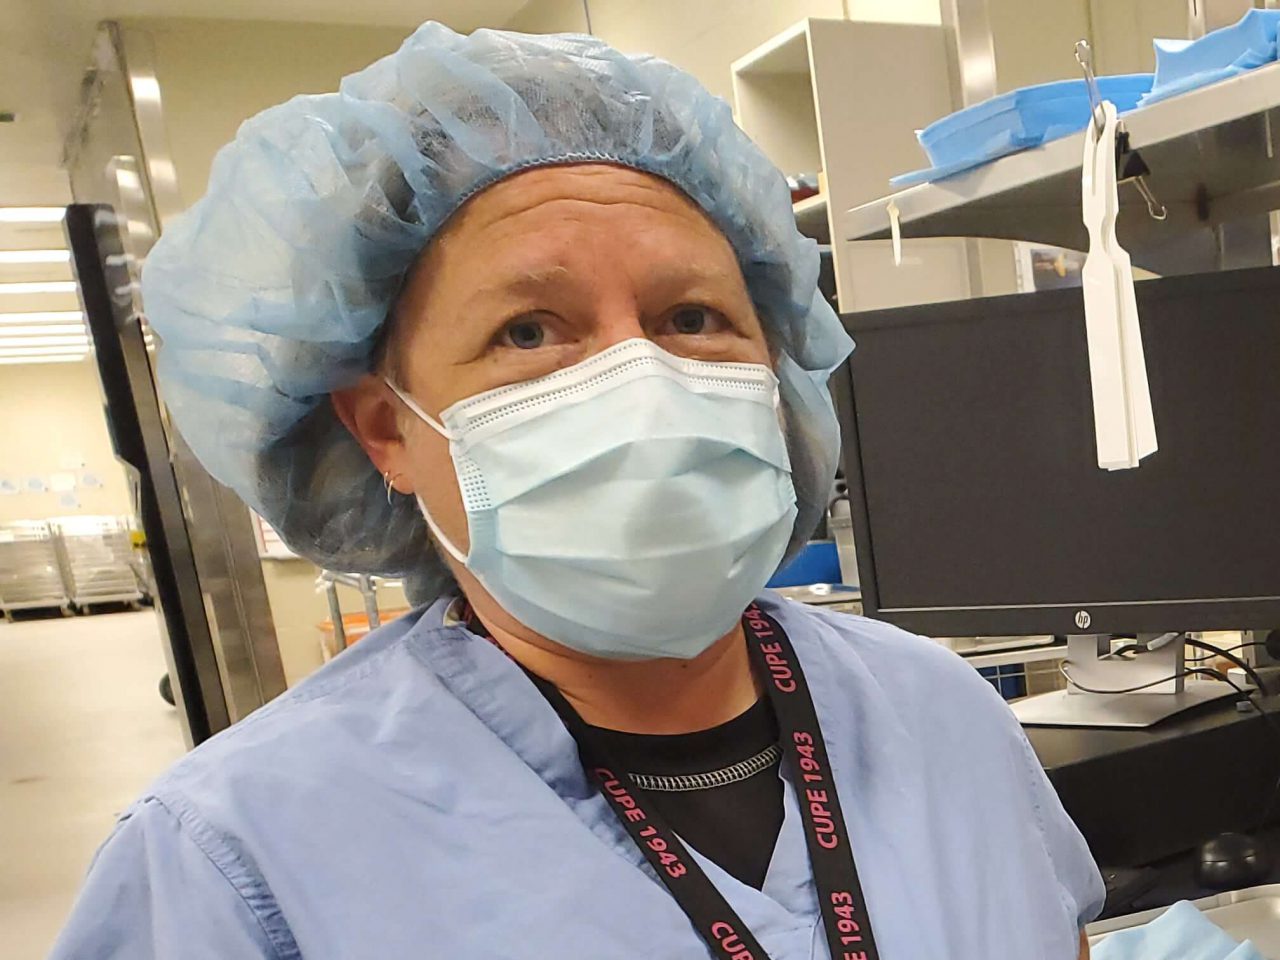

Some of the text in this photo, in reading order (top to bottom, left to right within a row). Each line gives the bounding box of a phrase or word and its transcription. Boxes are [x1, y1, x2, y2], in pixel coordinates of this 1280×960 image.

[1077, 610, 1089, 629] hp
[743, 602, 797, 693] CUPE 194
[793, 730, 839, 850] CUPE 1943
[639, 825, 687, 878] 1943
[831, 891, 864, 946] 1943
